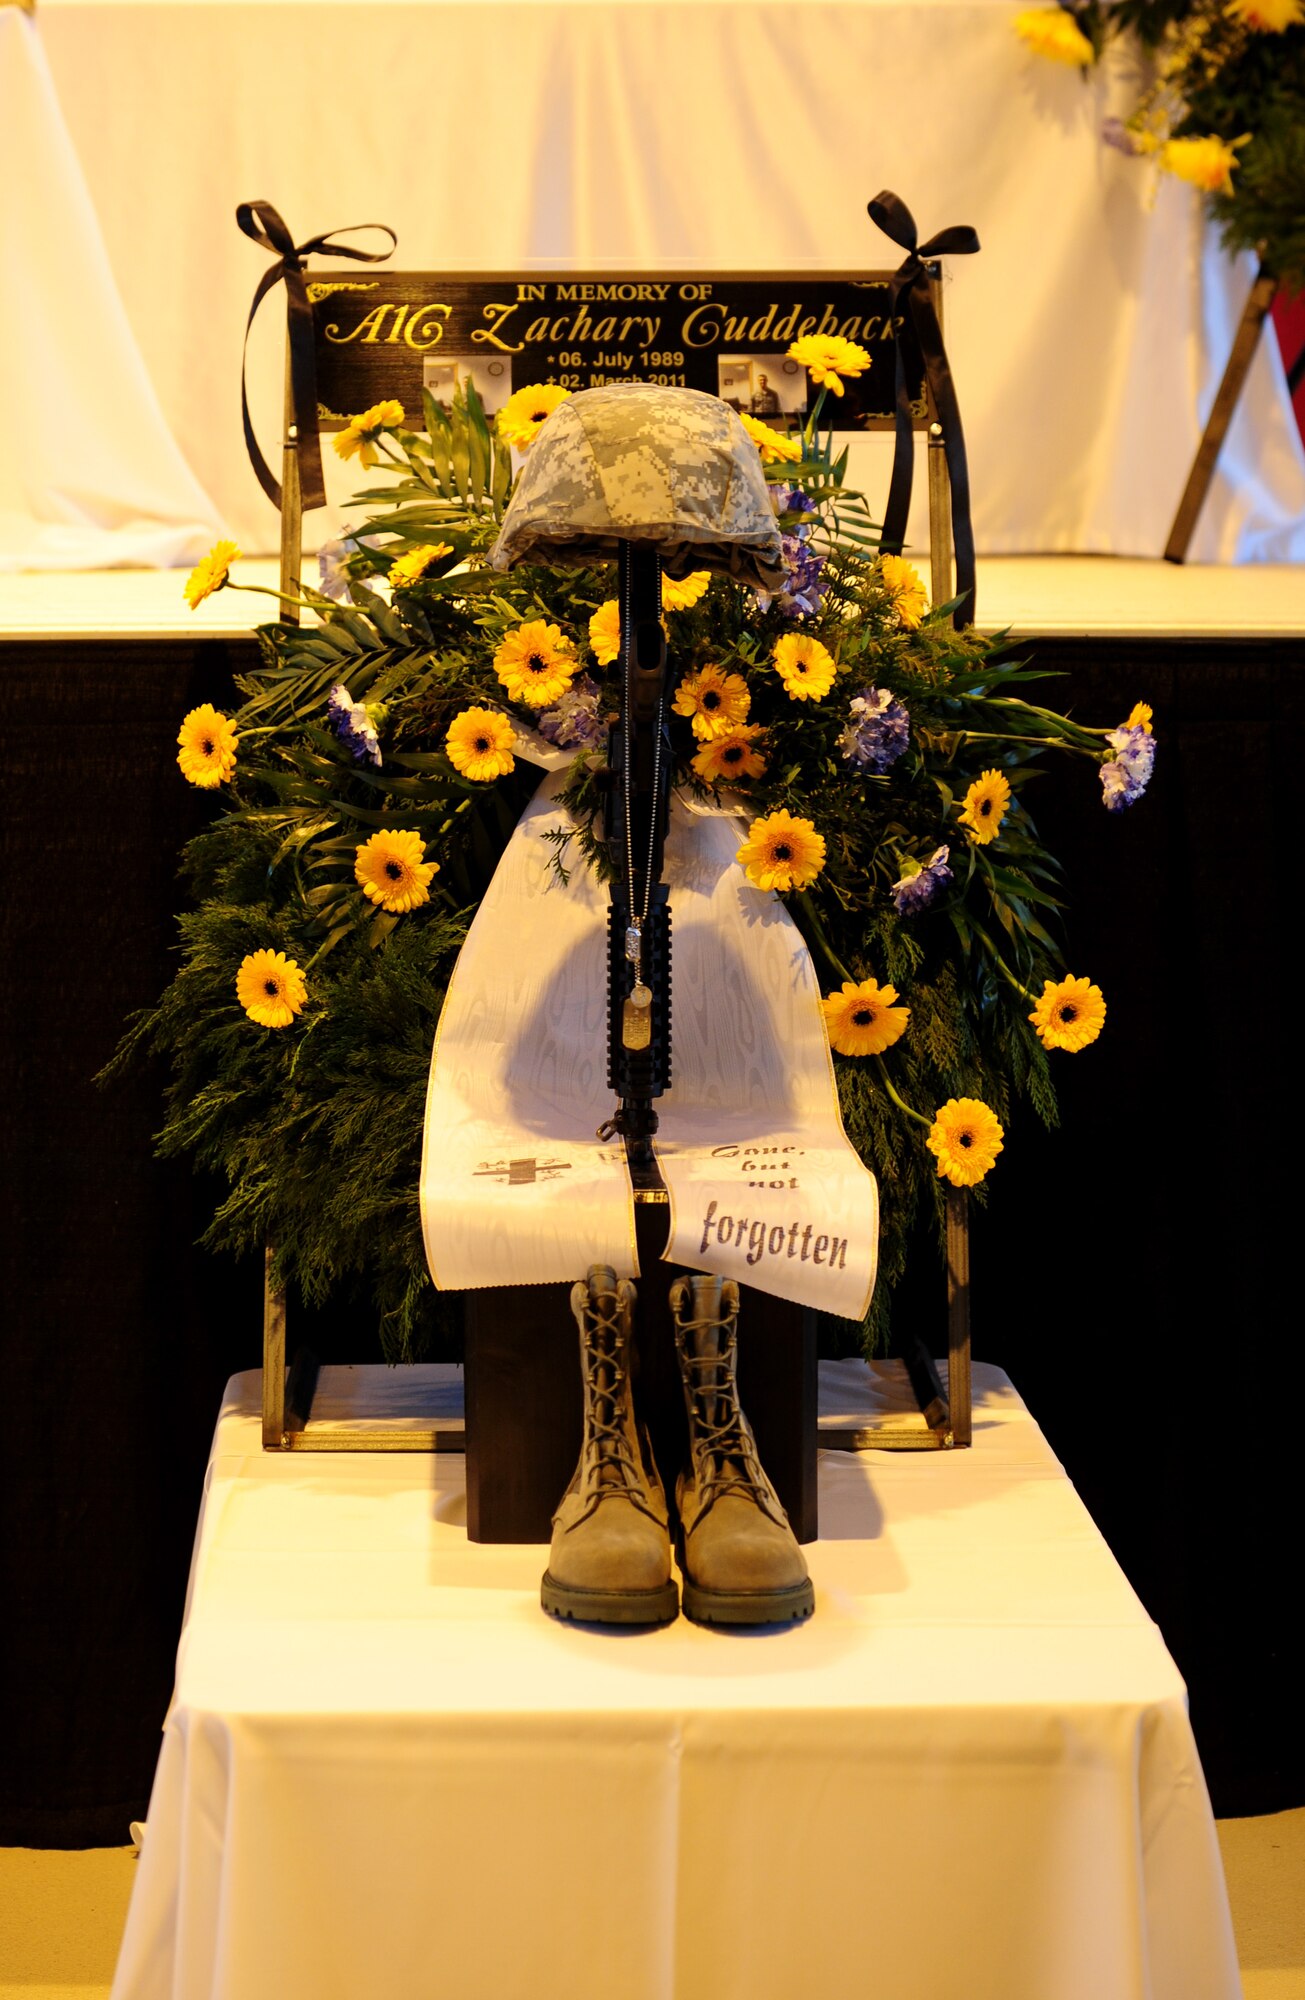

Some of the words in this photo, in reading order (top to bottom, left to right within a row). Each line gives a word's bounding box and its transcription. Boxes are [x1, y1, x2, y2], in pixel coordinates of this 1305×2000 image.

[517, 284, 547, 301] IN
[556, 284, 672, 301] MEMORY
[679, 284, 713, 301] OF
[325, 303, 453, 350] A1C
[470, 302, 661, 351] Zachary
[681, 302, 905, 348] Cuddeback
[559, 351, 588, 367] 06.
[592, 351, 634, 371] July
[640, 351, 685, 367] 1989
[559, 374, 586, 388] 02.
[648, 373, 686, 388] 2011
[741, 1160, 791, 1172] but
[748, 1177, 800, 1190] not
[699, 1200, 849, 1270] forgotten
